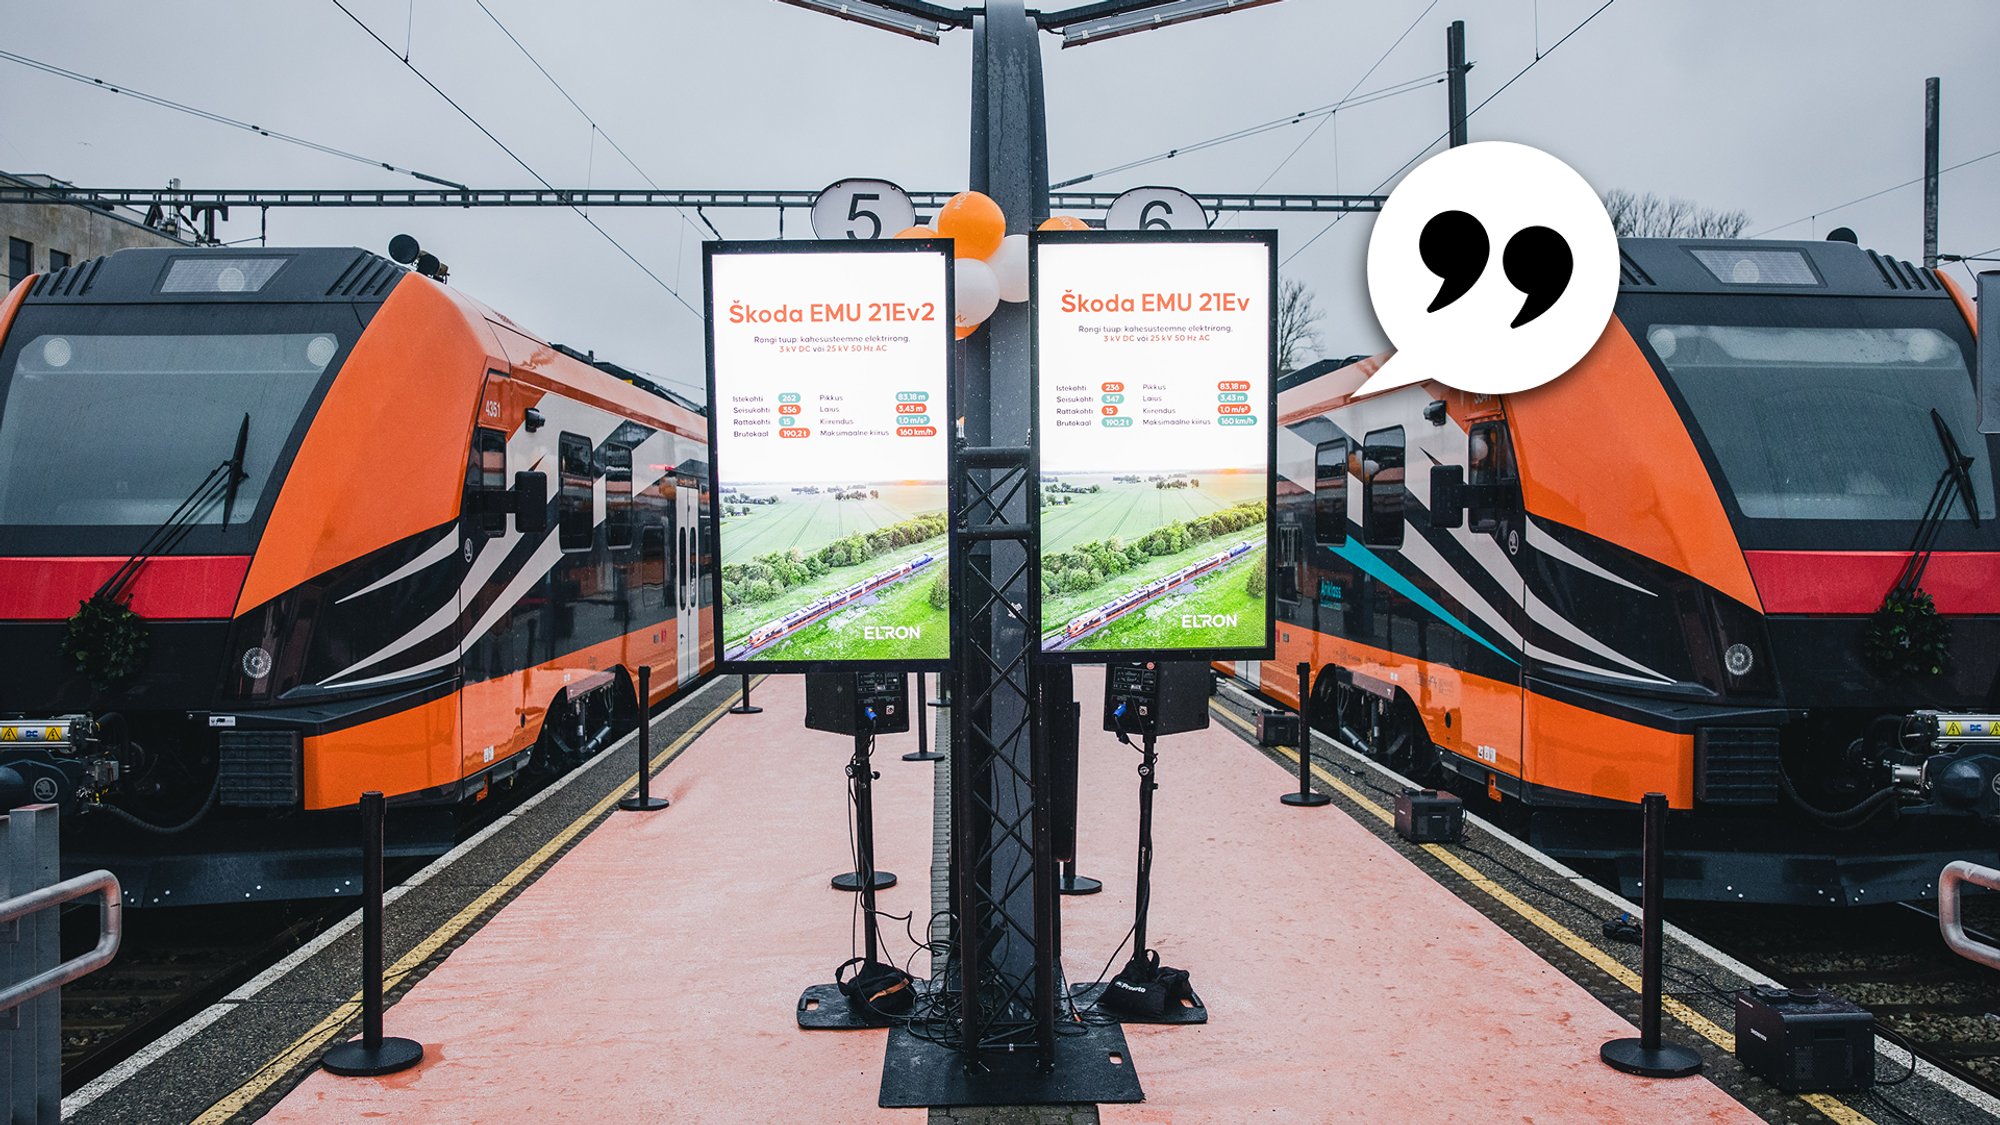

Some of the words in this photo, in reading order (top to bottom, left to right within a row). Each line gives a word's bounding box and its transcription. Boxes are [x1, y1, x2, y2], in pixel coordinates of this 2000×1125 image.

[846, 194, 882, 240] 5
[1061, 289, 1134, 313] Škoda
[1142, 293, 1192, 312] EMU
[1199, 293, 1250, 311] 21Ev
[729, 300, 803, 324] Škoda
[810, 303, 861, 323] EMU
[868, 302, 934, 322] 21Ev2
[1079, 325, 1101, 334] Rongi
[754, 336, 777, 344] Rongi
[1219, 394, 1236, 402] 3,43
[486, 400, 500, 417] 4351
[1182, 613, 1237, 628] ELRON
[864, 626, 920, 640] ELRON
